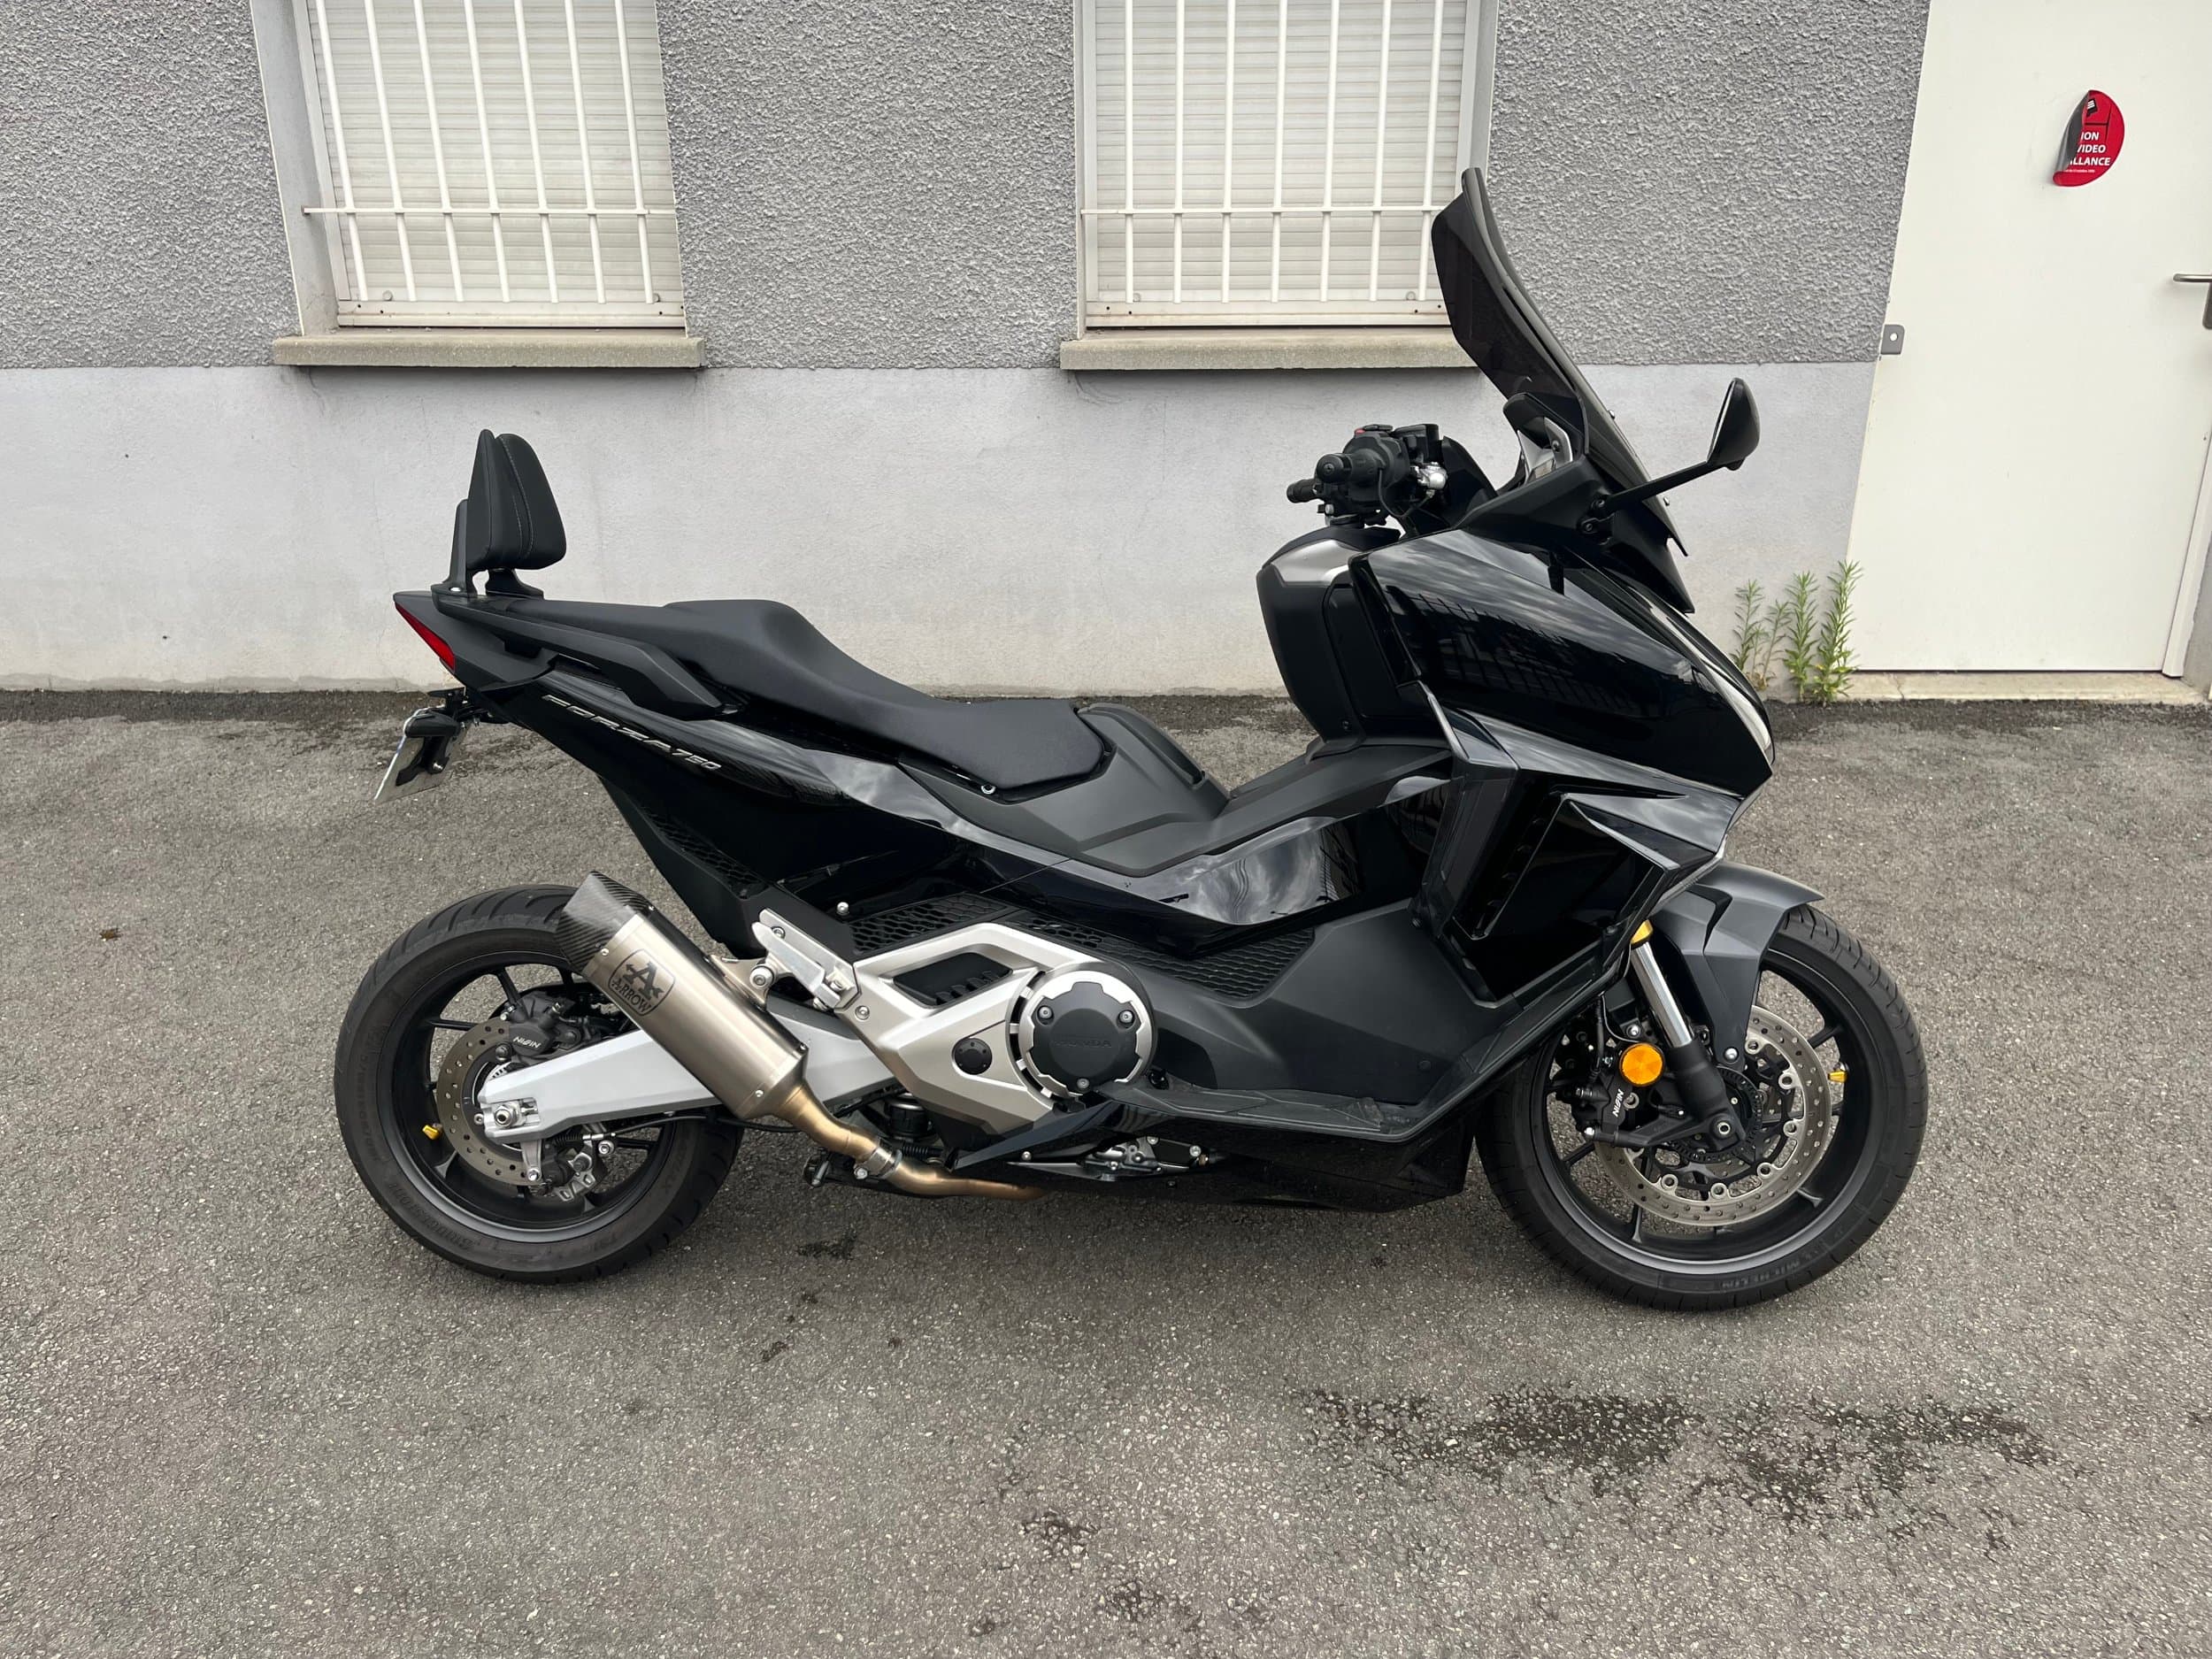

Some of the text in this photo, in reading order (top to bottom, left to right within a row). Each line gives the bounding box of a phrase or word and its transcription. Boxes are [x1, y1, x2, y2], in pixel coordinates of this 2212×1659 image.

[541, 695, 722, 770] FORZA 750
[611, 978, 652, 1012] ARROW
